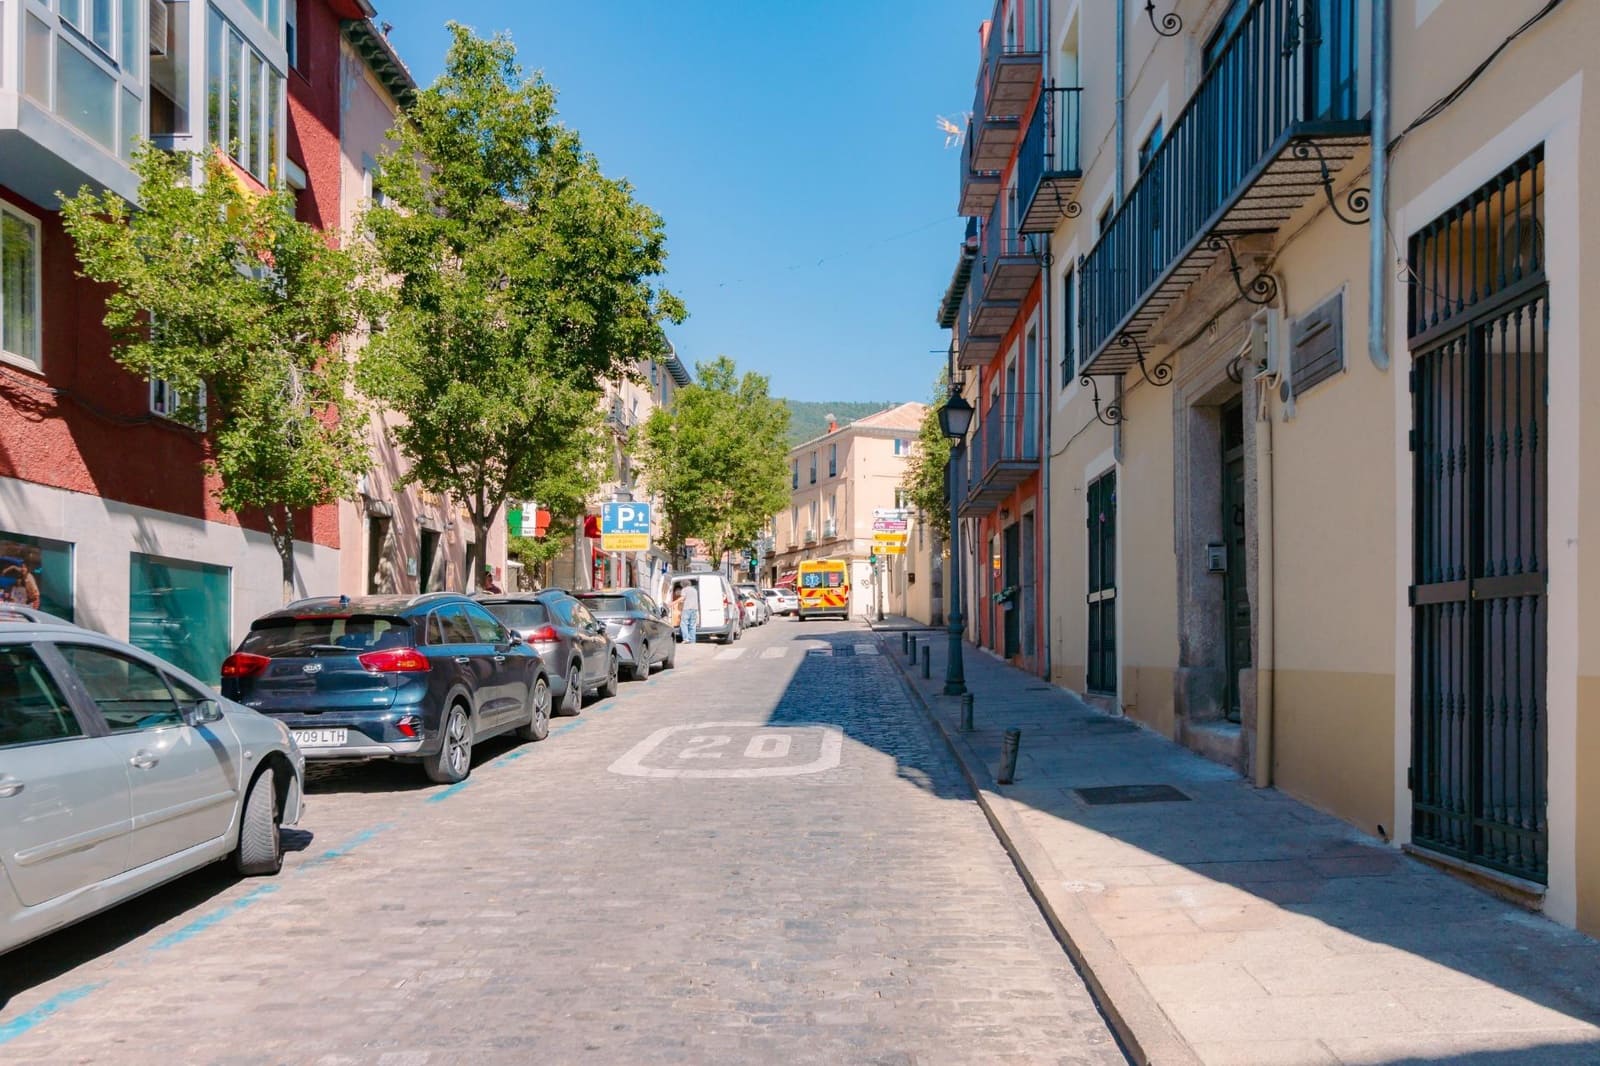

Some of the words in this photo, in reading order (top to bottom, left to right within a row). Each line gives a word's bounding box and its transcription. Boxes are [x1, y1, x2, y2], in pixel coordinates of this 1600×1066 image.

[618, 507, 635, 529] P
[295, 731, 318, 743] 709
[321, 731, 345, 743] LTH
[679, 734, 792, 759] 20
